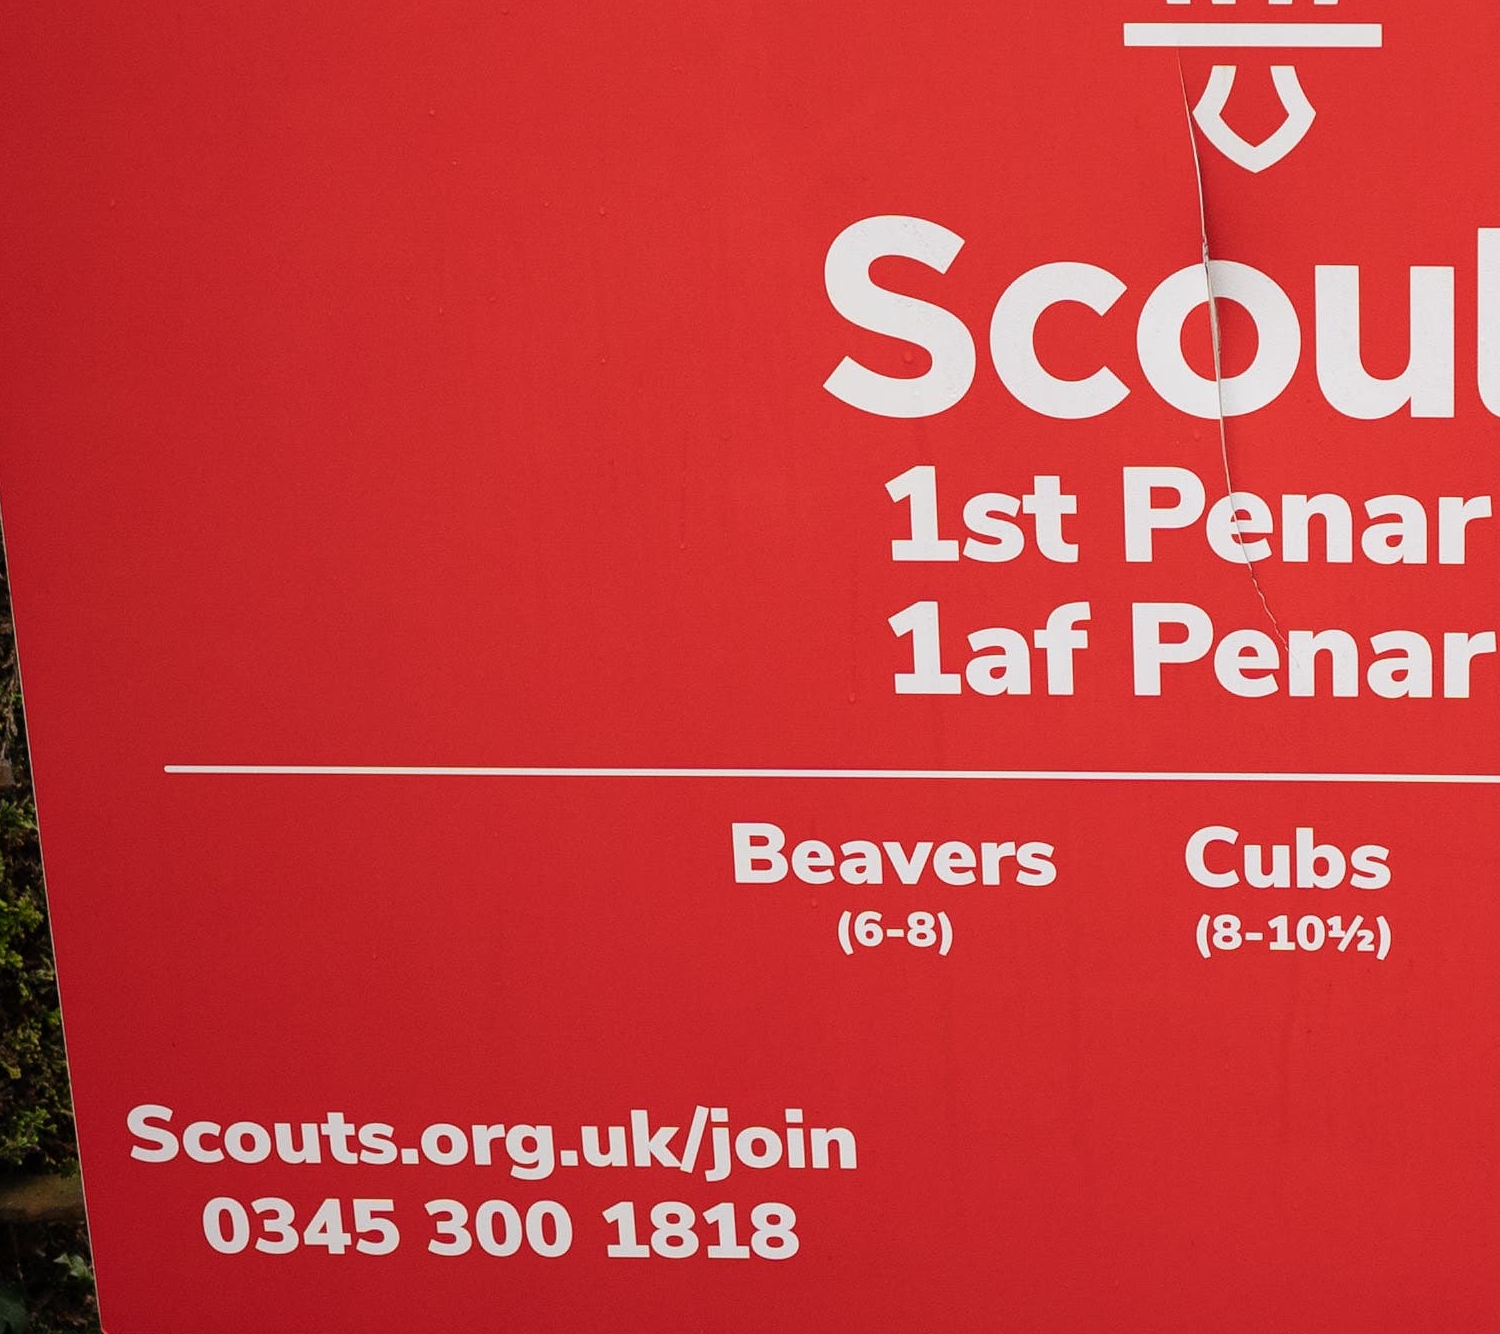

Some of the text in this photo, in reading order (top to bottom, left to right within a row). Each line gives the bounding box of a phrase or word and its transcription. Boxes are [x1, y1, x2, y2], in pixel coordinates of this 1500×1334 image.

[883, 464, 1080, 564] 1st
[887, 599, 1093, 697] 1af
[730, 821, 1058, 888] Beavers
[1184, 824, 1393, 891] Cubs
[836, 909, 954, 957] (6-8)
[1195, 913, 1393, 962] (8-10½)
[125, 1103, 858, 1183] Scouts.org.uk/join
[201, 1195, 801, 1261] 0345 300 1818
